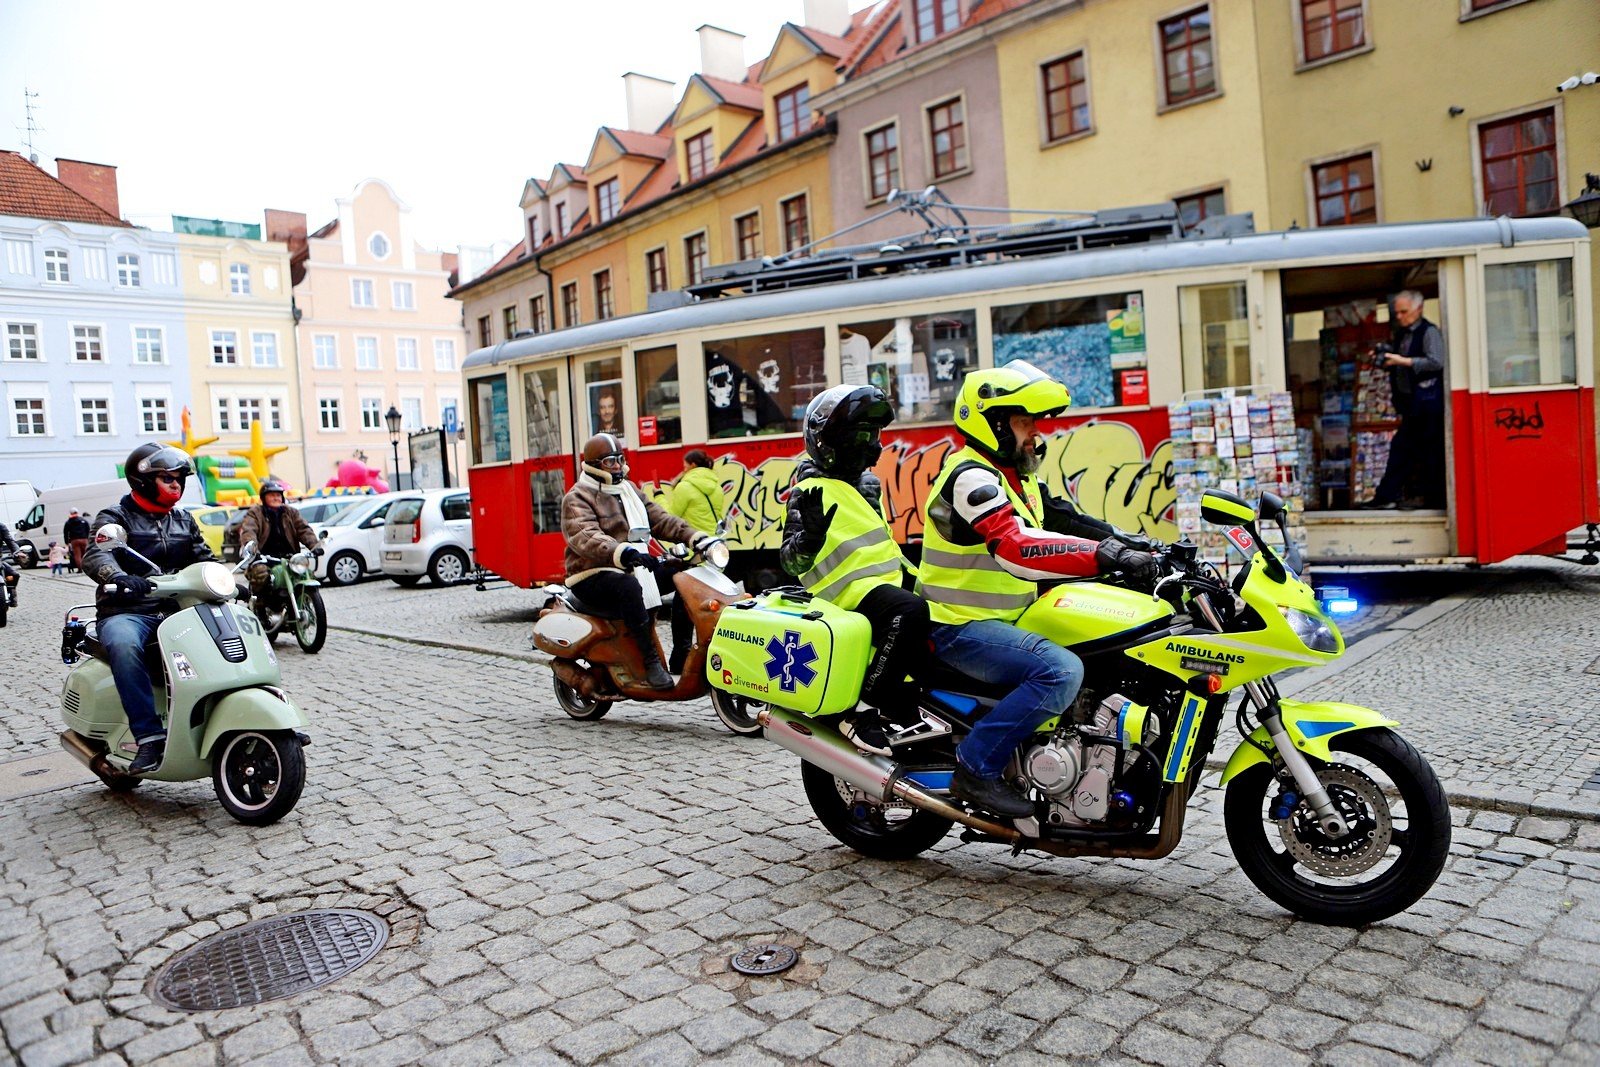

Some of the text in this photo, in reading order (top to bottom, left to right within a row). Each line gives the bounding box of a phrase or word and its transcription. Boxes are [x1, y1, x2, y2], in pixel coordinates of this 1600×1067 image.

[447, 409, 455, 432] P
[1075, 601, 1136, 619] divemed
[237, 614, 262, 637] 67
[717, 627, 765, 647] AMBULANS
[1165, 641, 1246, 664] AMBULANS
[733, 675, 769, 693] divemed
